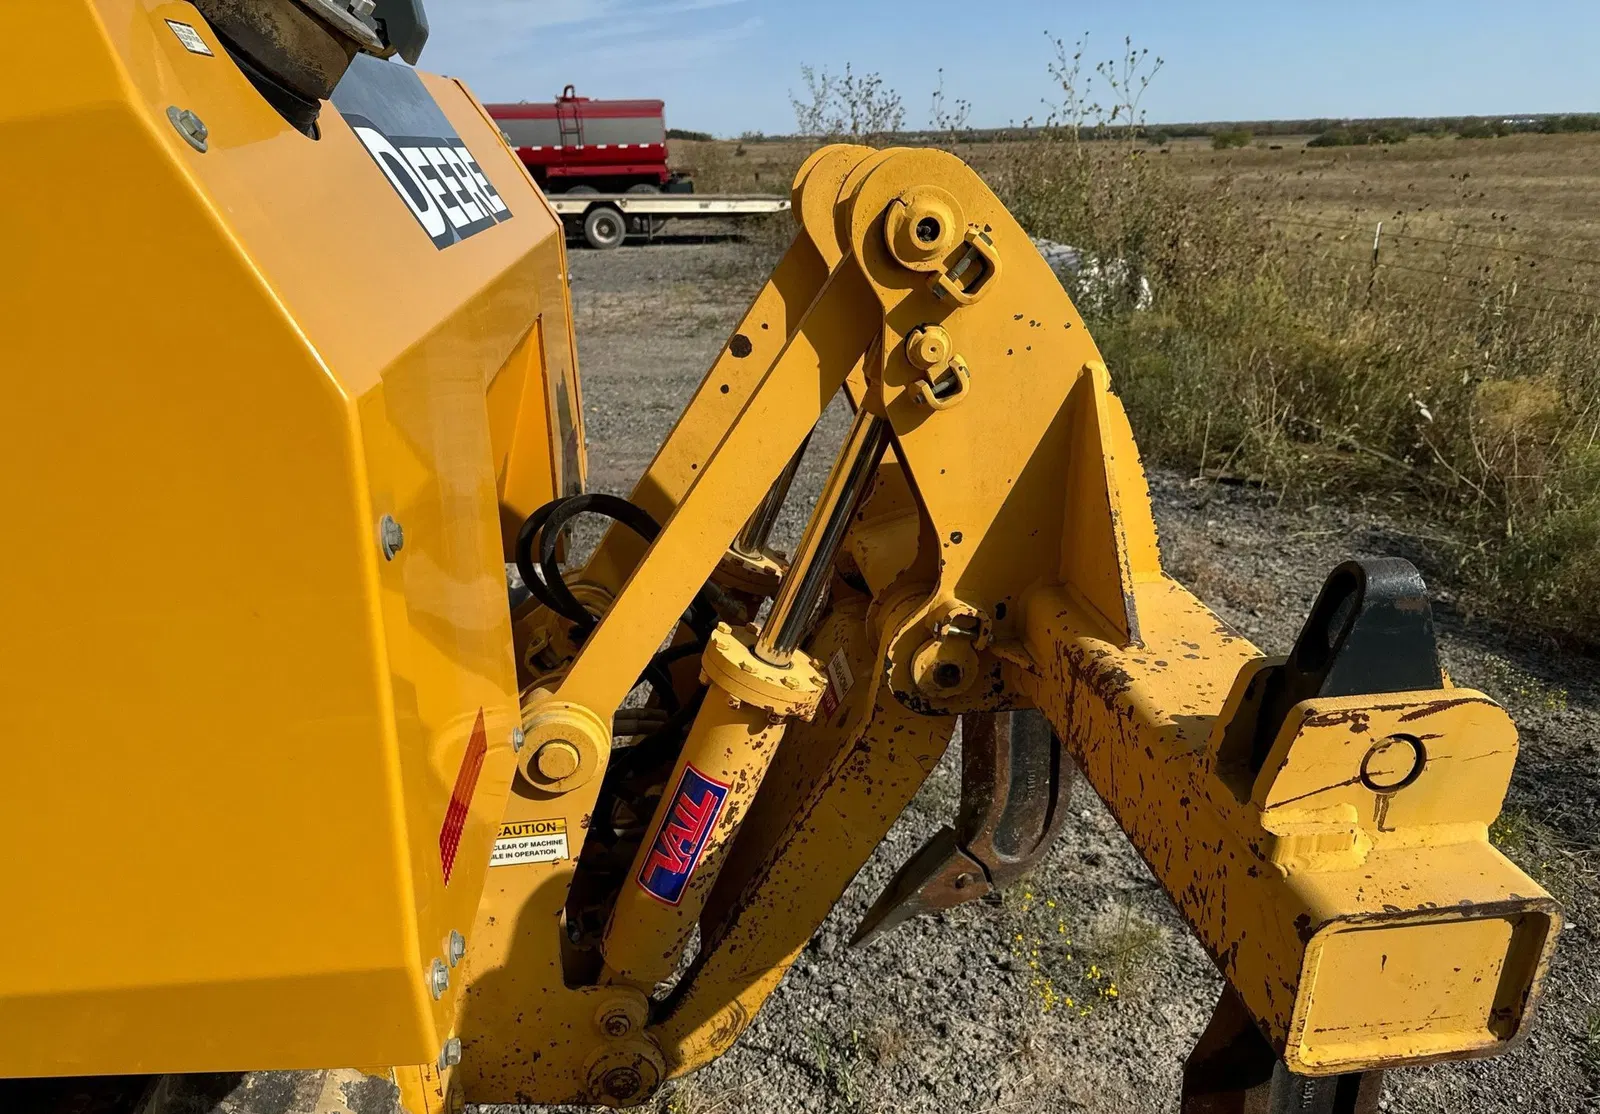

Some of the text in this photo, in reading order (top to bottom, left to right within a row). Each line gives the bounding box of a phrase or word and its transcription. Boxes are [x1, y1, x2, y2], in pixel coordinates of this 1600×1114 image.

[353, 127, 507, 238] DEERE
[514, 848, 556, 858] OPERATION
[530, 839, 563, 848] MACHINE
[643, 790, 718, 884] VAIL
